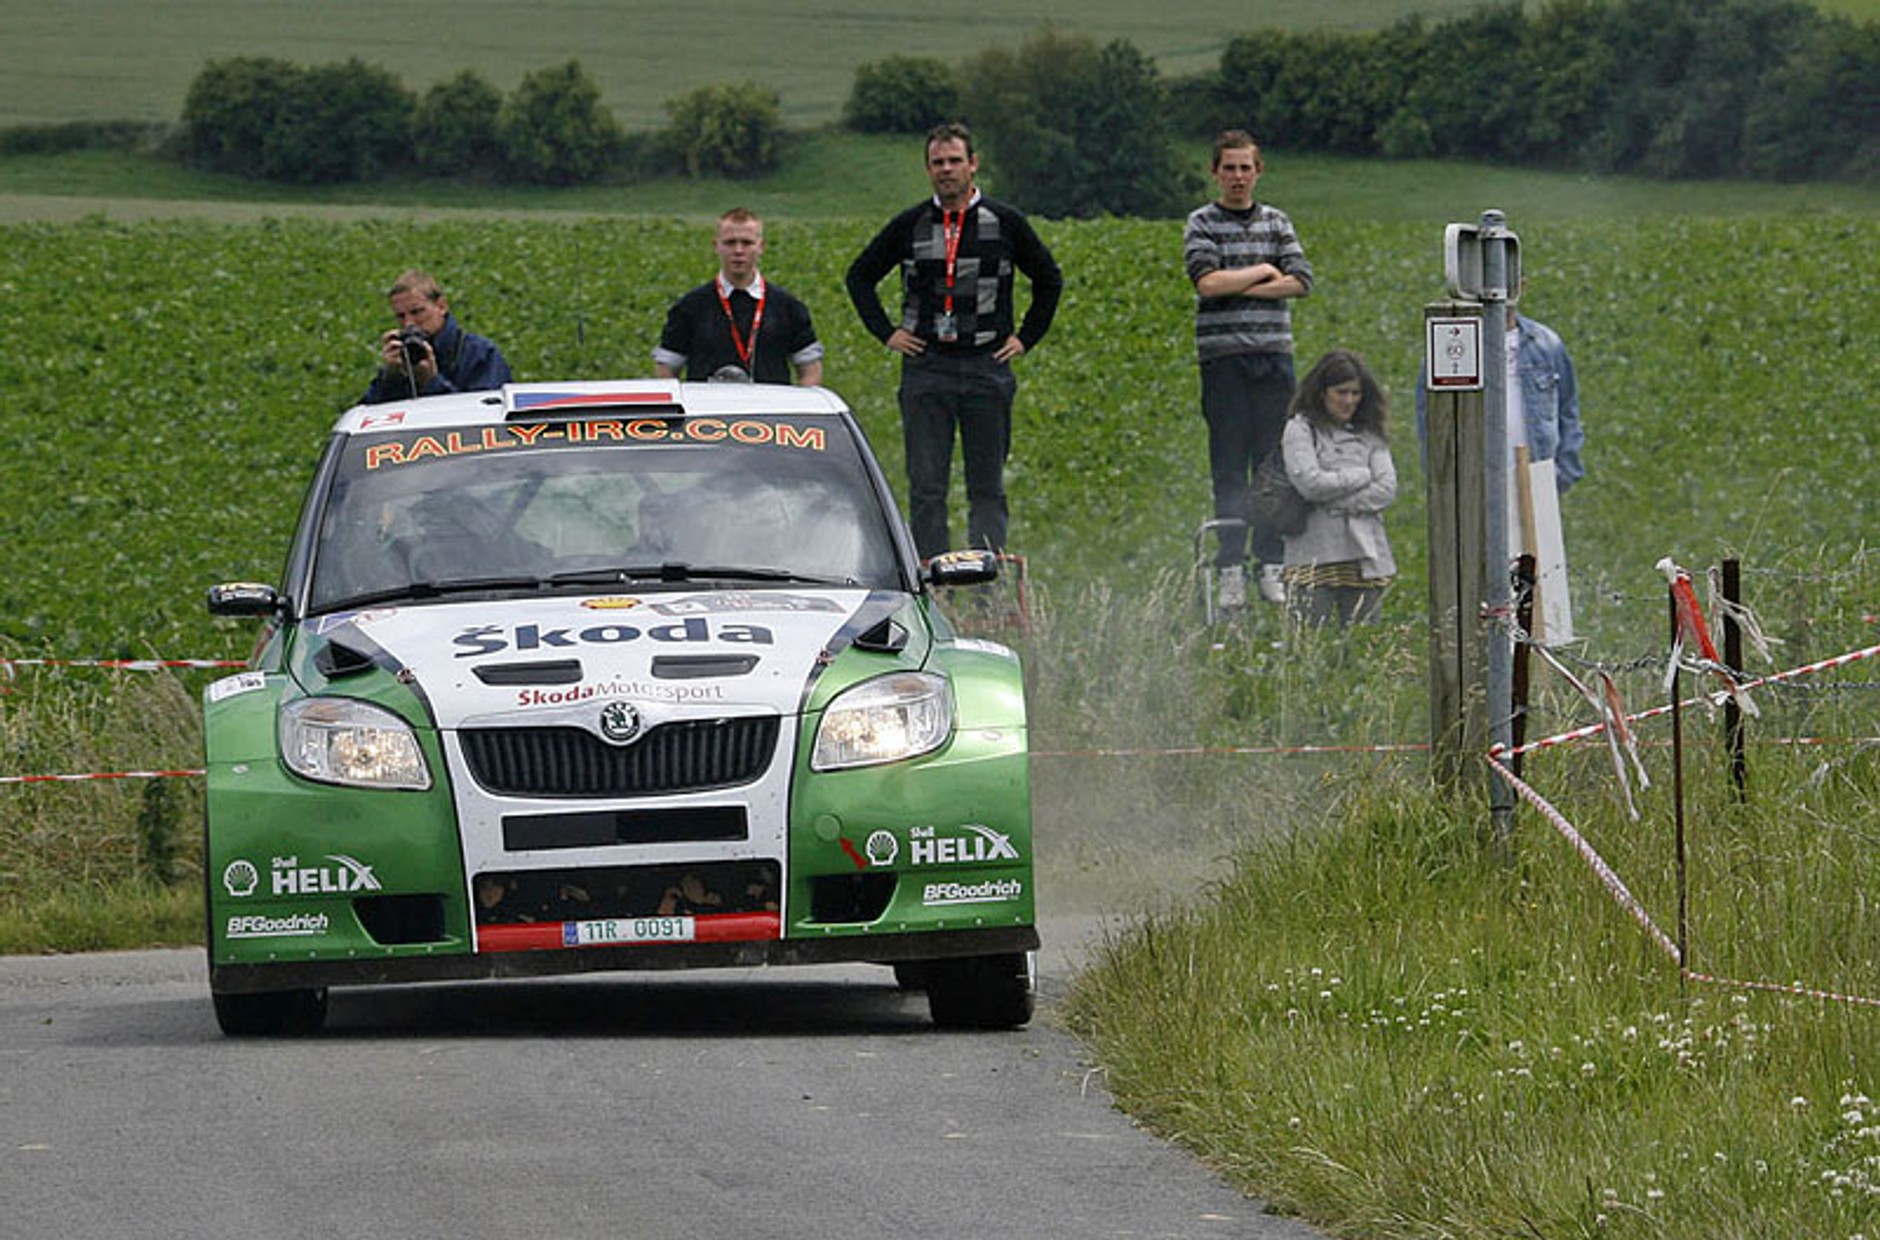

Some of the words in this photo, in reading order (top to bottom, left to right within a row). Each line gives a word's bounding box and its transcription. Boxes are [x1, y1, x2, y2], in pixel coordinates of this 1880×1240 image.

[365, 419, 826, 468] RALLY-IRC.COM
[910, 824, 1019, 864] HELIX
[271, 854, 382, 895] HELIX
[923, 879, 1022, 900] BFGoodrich
[227, 913, 328, 933] BFGoodrich
[585, 921, 617, 940] 11R
[634, 918, 684, 937] 0091
